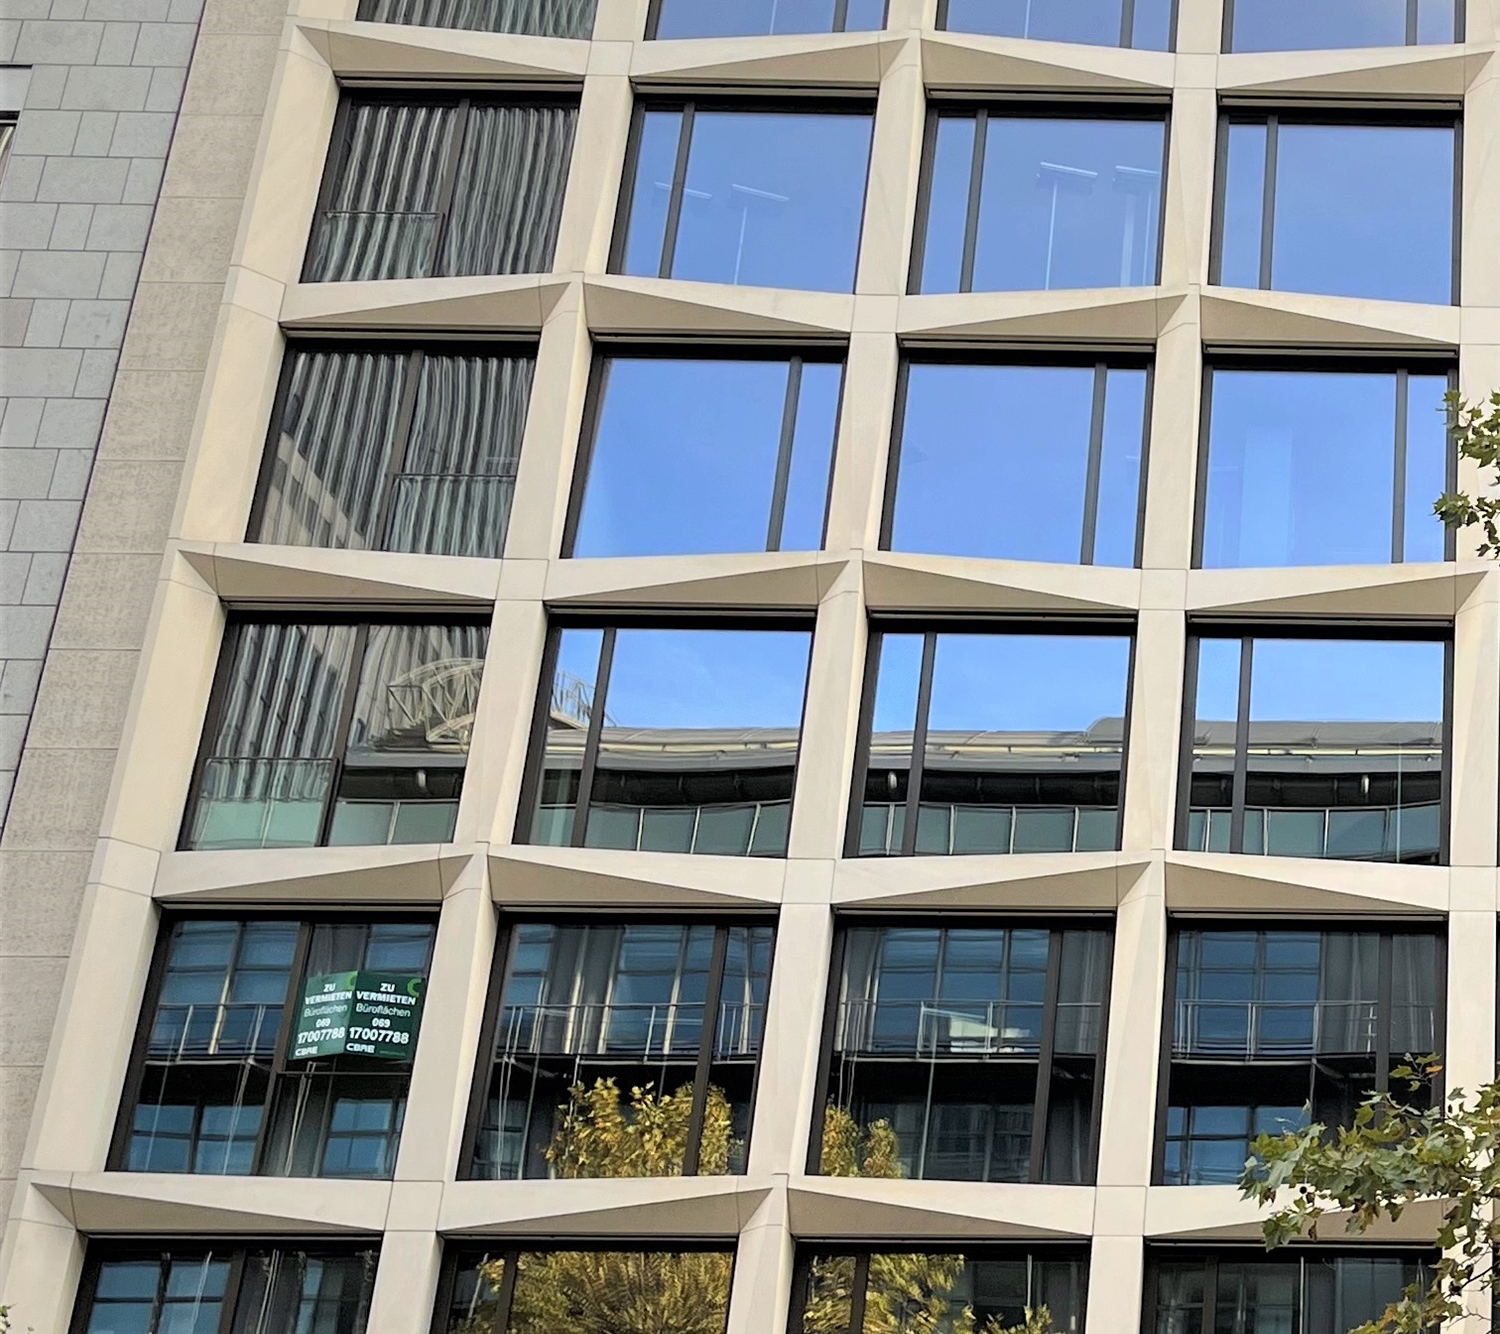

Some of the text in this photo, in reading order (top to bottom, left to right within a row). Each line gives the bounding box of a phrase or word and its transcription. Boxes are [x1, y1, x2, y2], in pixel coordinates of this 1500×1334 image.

[323, 983, 336, 992] ZU
[380, 983, 395, 992] ZU
[305, 991, 352, 1005] VERMIETEN
[356, 991, 416, 1005] VERMIETEN
[355, 1003, 411, 1017] Büroflächen
[315, 1018, 331, 1028] 069
[371, 1018, 391, 1028] 069
[297, 1027, 345, 1044] 17007788
[349, 1027, 410, 1044] 17007788
[295, 1046, 318, 1056] CBRE
[346, 1043, 375, 1053] CBRE
